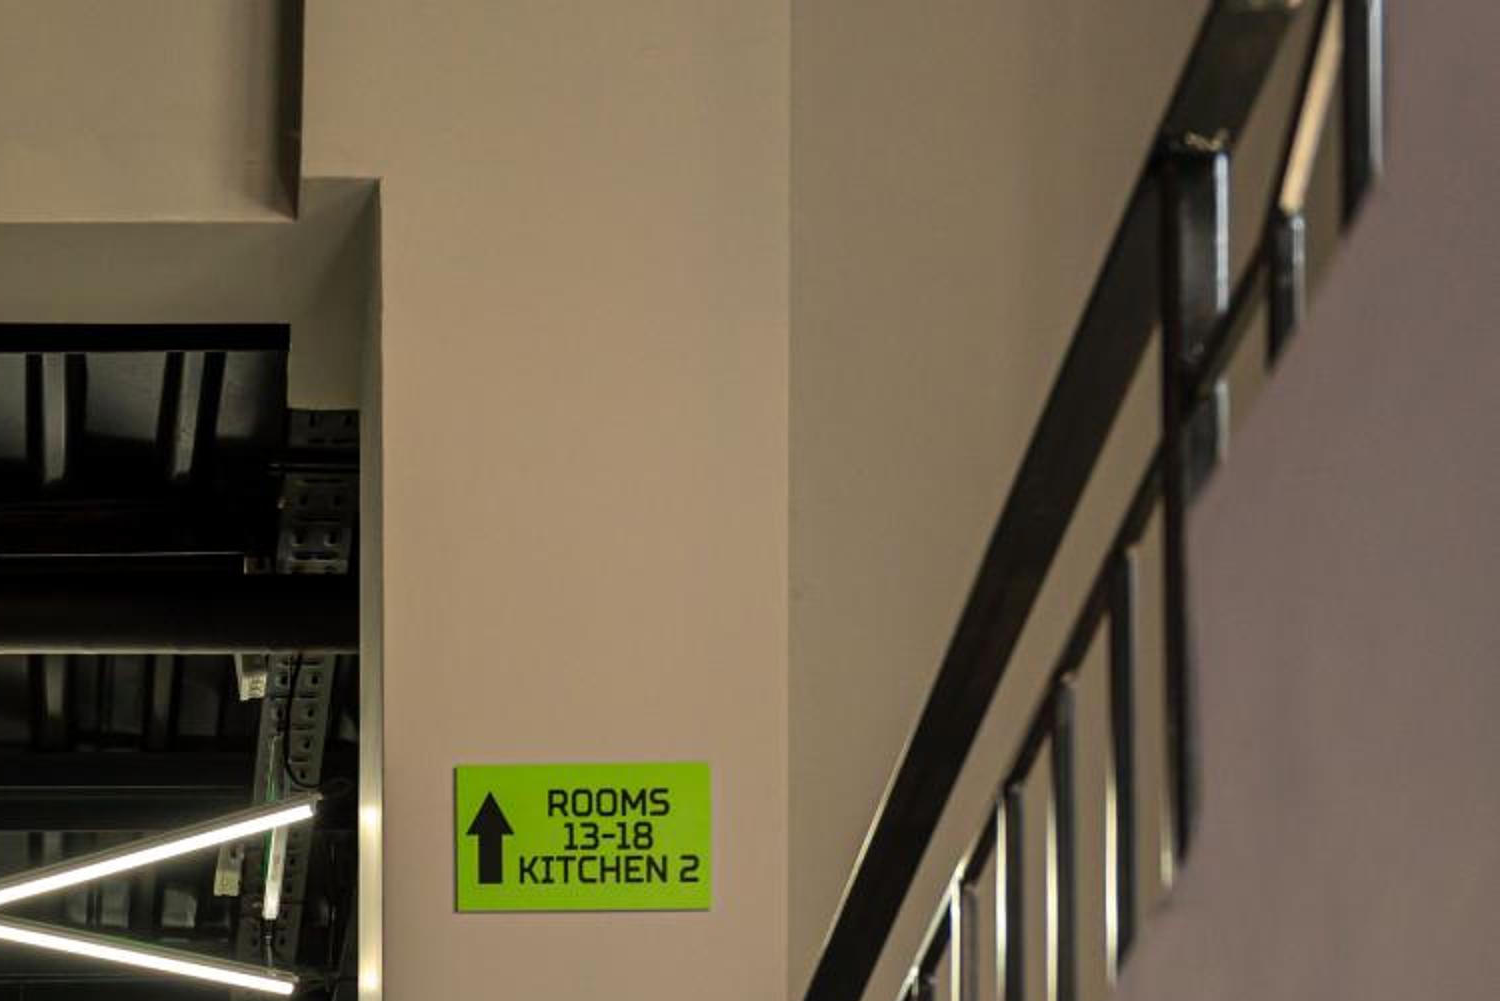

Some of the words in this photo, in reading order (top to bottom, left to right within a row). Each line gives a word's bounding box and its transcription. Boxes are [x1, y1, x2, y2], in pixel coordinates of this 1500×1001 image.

[548, 788, 670, 817] ROOMS
[563, 822, 654, 850] 13-18
[519, 855, 668, 884] KITCHEN
[679, 855, 699, 883] 2
